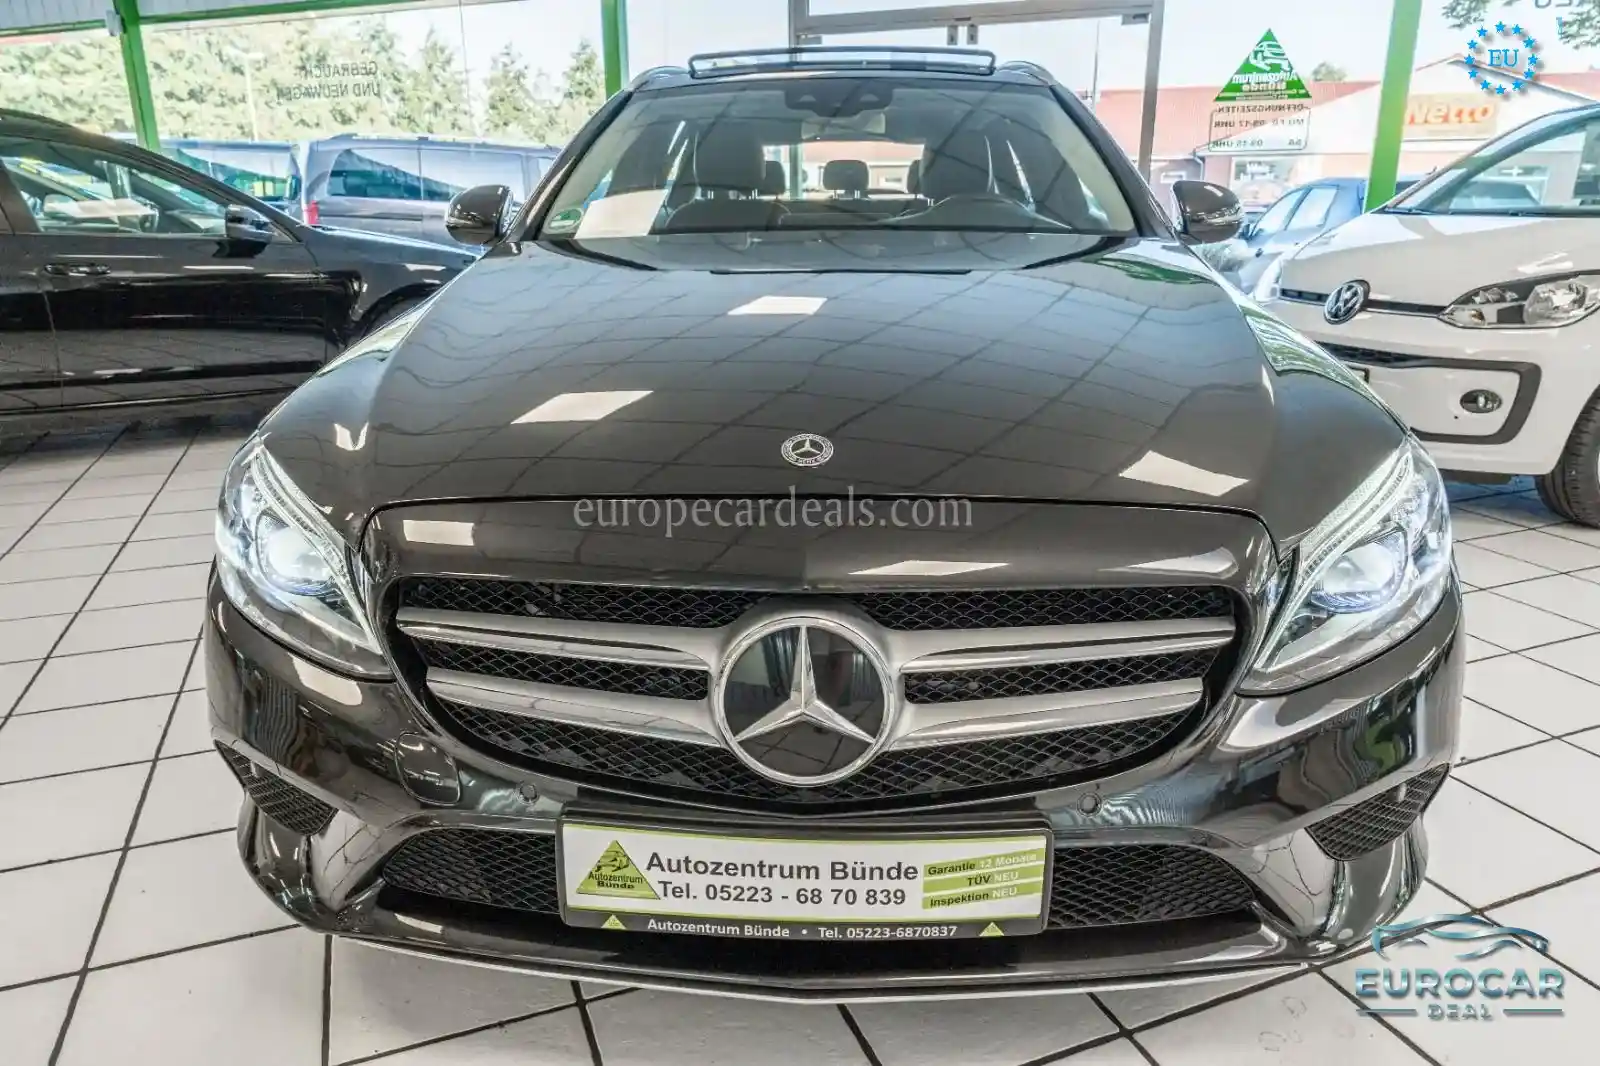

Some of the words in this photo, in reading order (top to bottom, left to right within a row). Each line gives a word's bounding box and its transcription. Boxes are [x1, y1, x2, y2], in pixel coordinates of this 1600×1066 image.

[646, 852, 820, 880] Autozentrum
[830, 860, 919, 881] Bünde
[928, 862, 976, 876] Garantie
[588, 871, 643, 884] Autozentrum
[597, 880, 635, 889] Bünde
[967, 873, 991, 886] TÜV
[994, 871, 1019, 882] NEU
[658, 880, 697, 900] Tel.
[705, 884, 773, 903] 05223
[796, 887, 822, 905] 68
[830, 888, 857, 905] 70
[865, 888, 906, 905] 839
[930, 892, 989, 908] Inspektion
[992, 886, 1018, 899] NEU
[647, 918, 740, 936] Autozentrum
[744, 922, 790, 937] Bünde
[818, 926, 842, 938] Tel.
[846, 925, 958, 939] 05223-6870837
